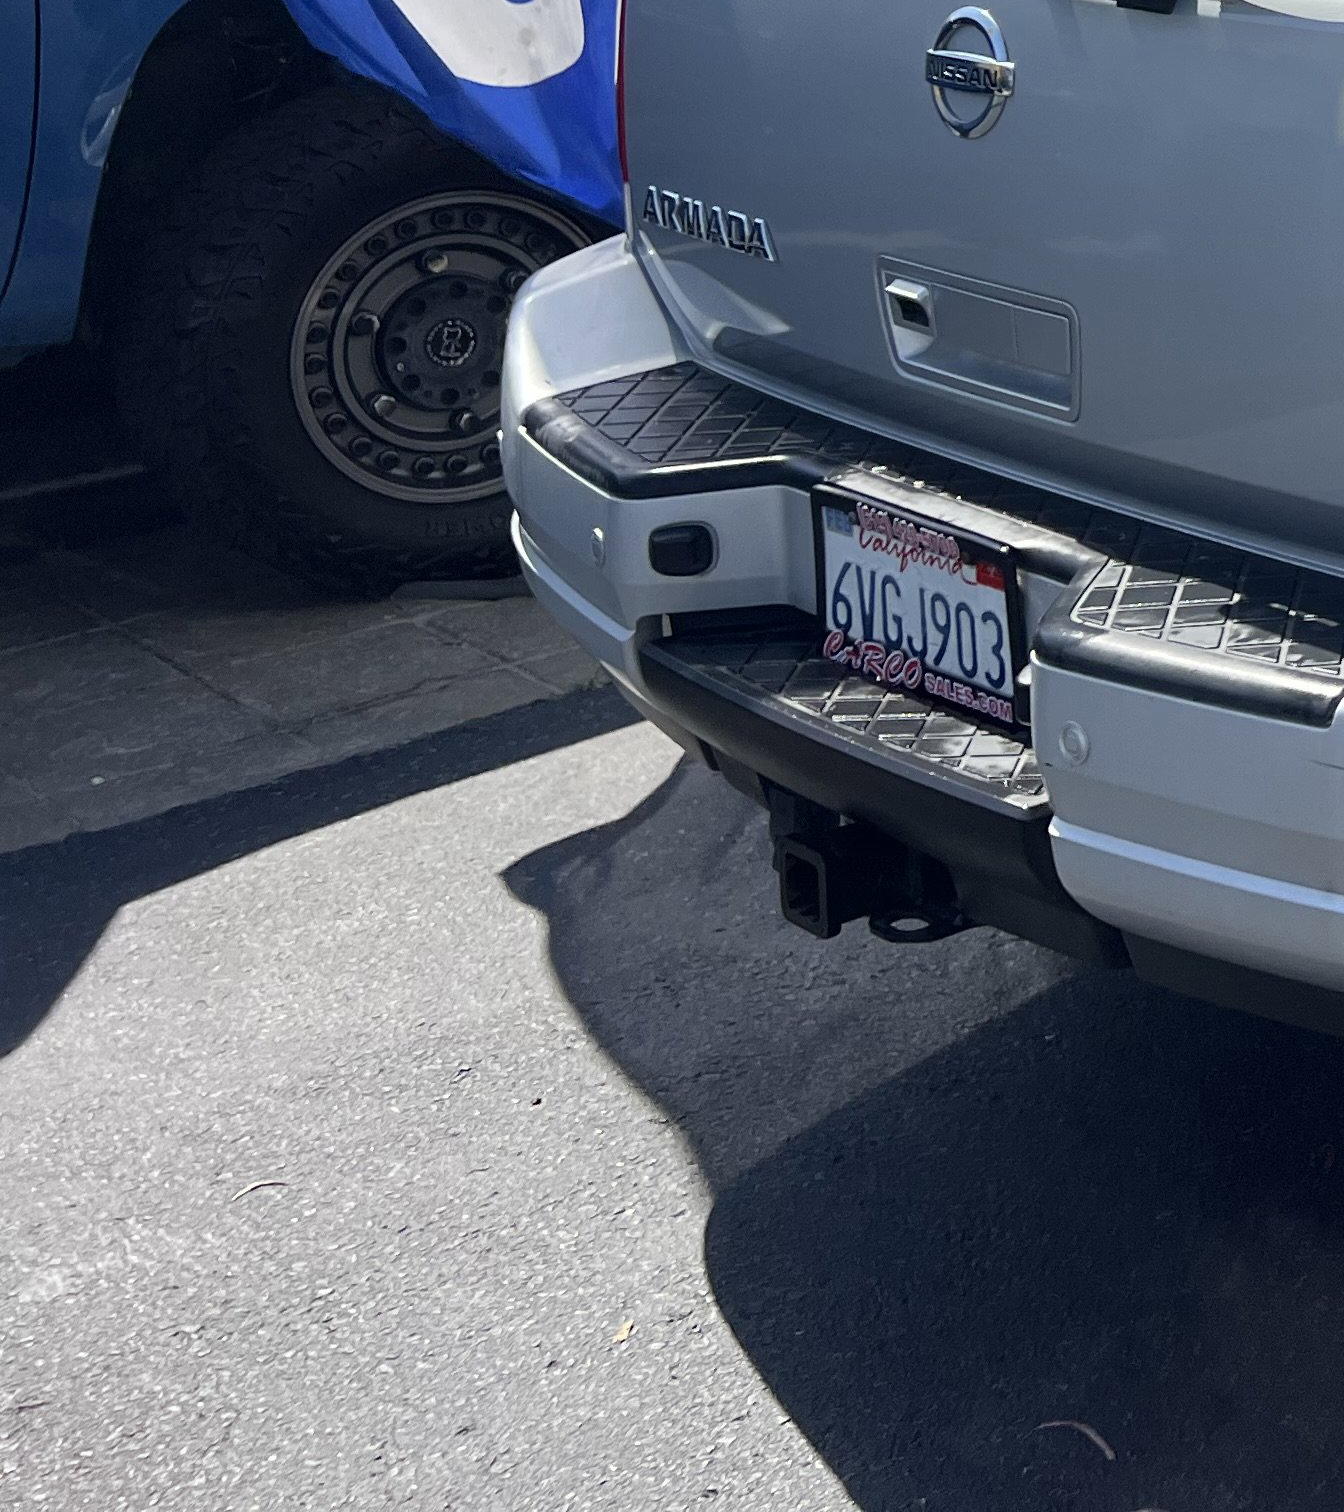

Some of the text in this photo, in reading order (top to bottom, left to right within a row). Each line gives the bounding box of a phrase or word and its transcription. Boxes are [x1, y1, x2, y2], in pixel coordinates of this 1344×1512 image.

[927, 56, 999, 89] NISSAN
[642, 184, 776, 263] ARMADA
[832, 562, 1006, 688] 6VGJ903
[823, 630, 1014, 724] CARCO SALES.COM
